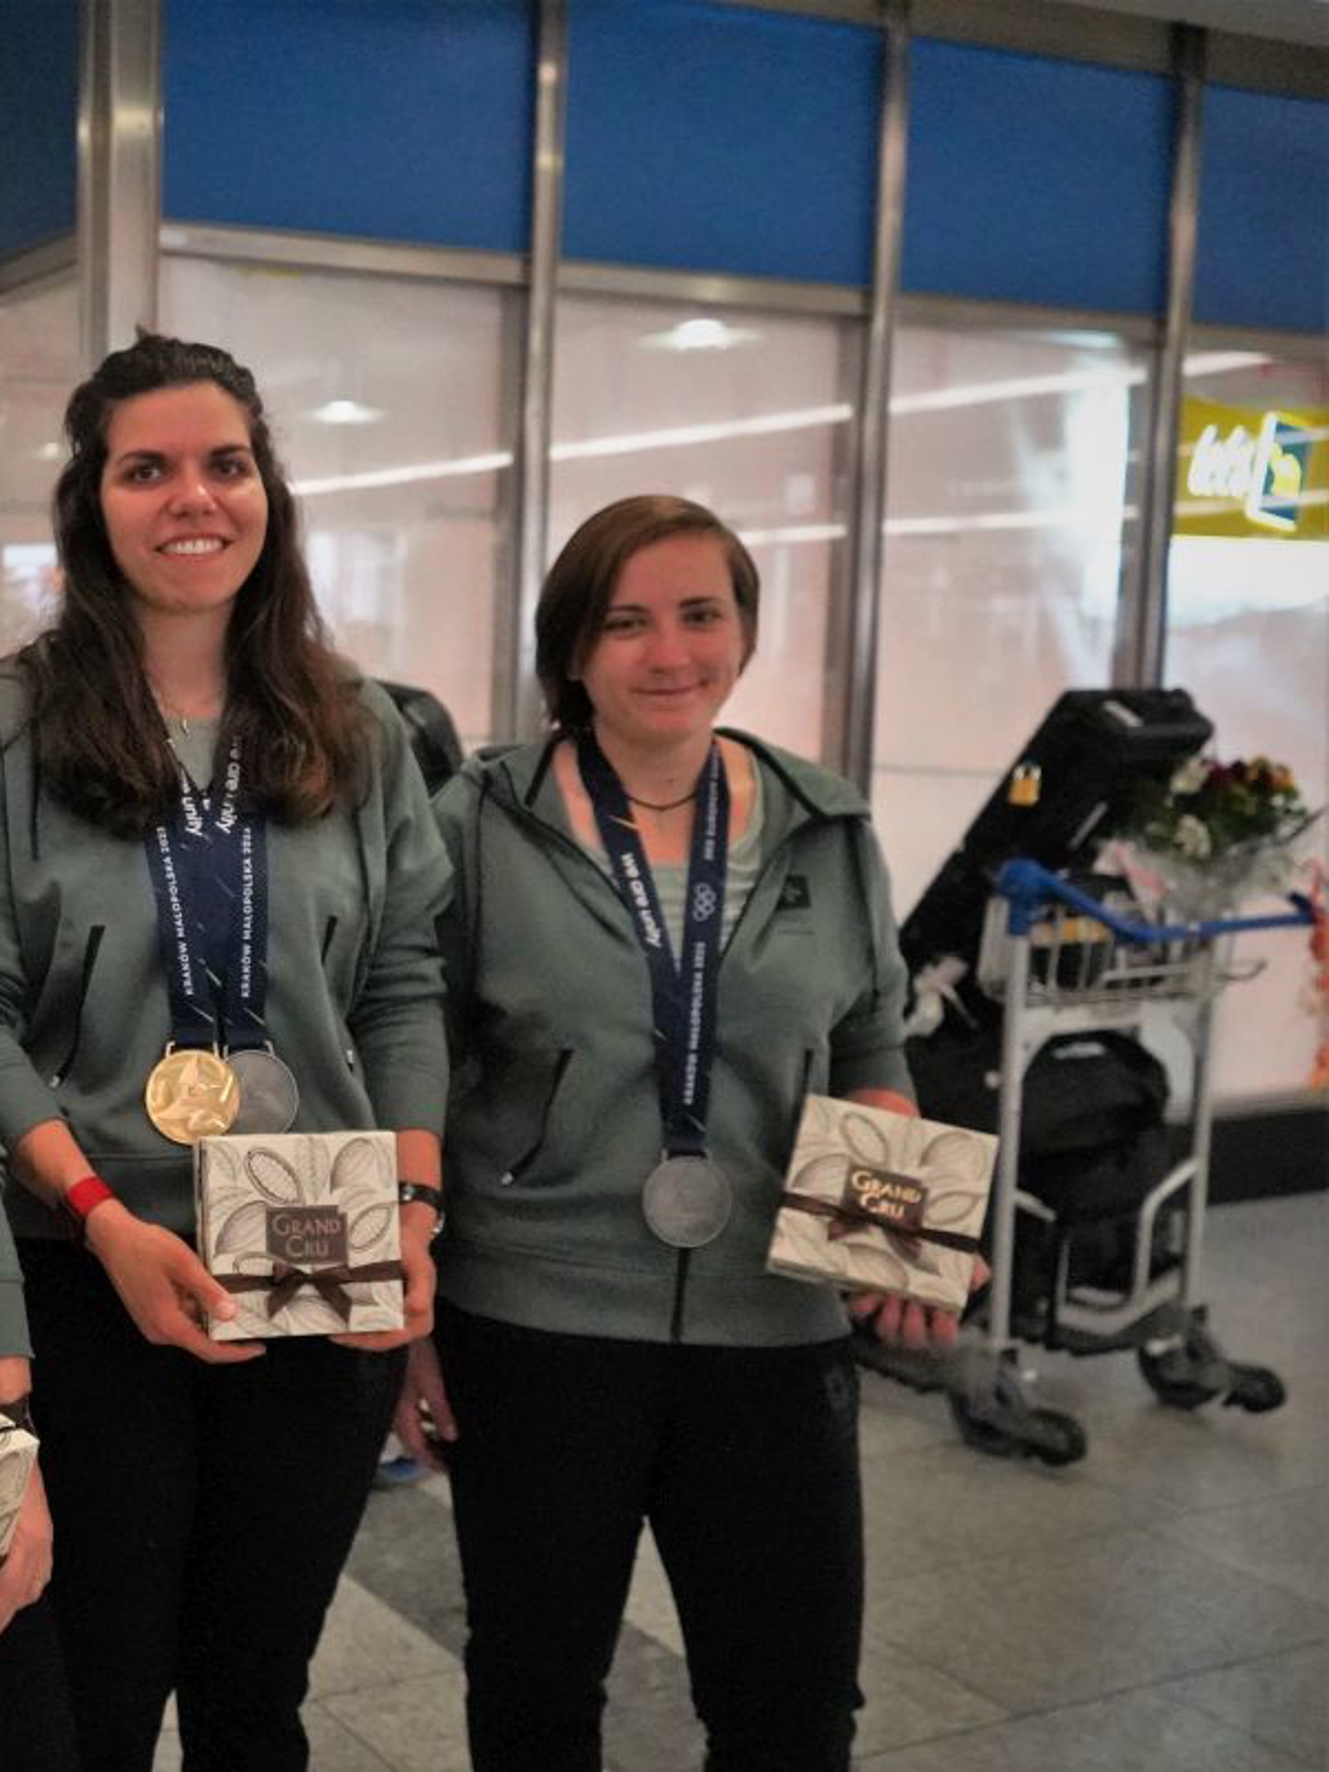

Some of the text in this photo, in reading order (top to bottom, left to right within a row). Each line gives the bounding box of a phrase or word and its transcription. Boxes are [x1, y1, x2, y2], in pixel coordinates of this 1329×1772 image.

[182, 797, 204, 836] unity
[852, 1170, 922, 1203] GRAND
[860, 1193, 905, 1219] CRU
[272, 1213, 340, 1236] GRAND
[285, 1235, 329, 1258] CRU
